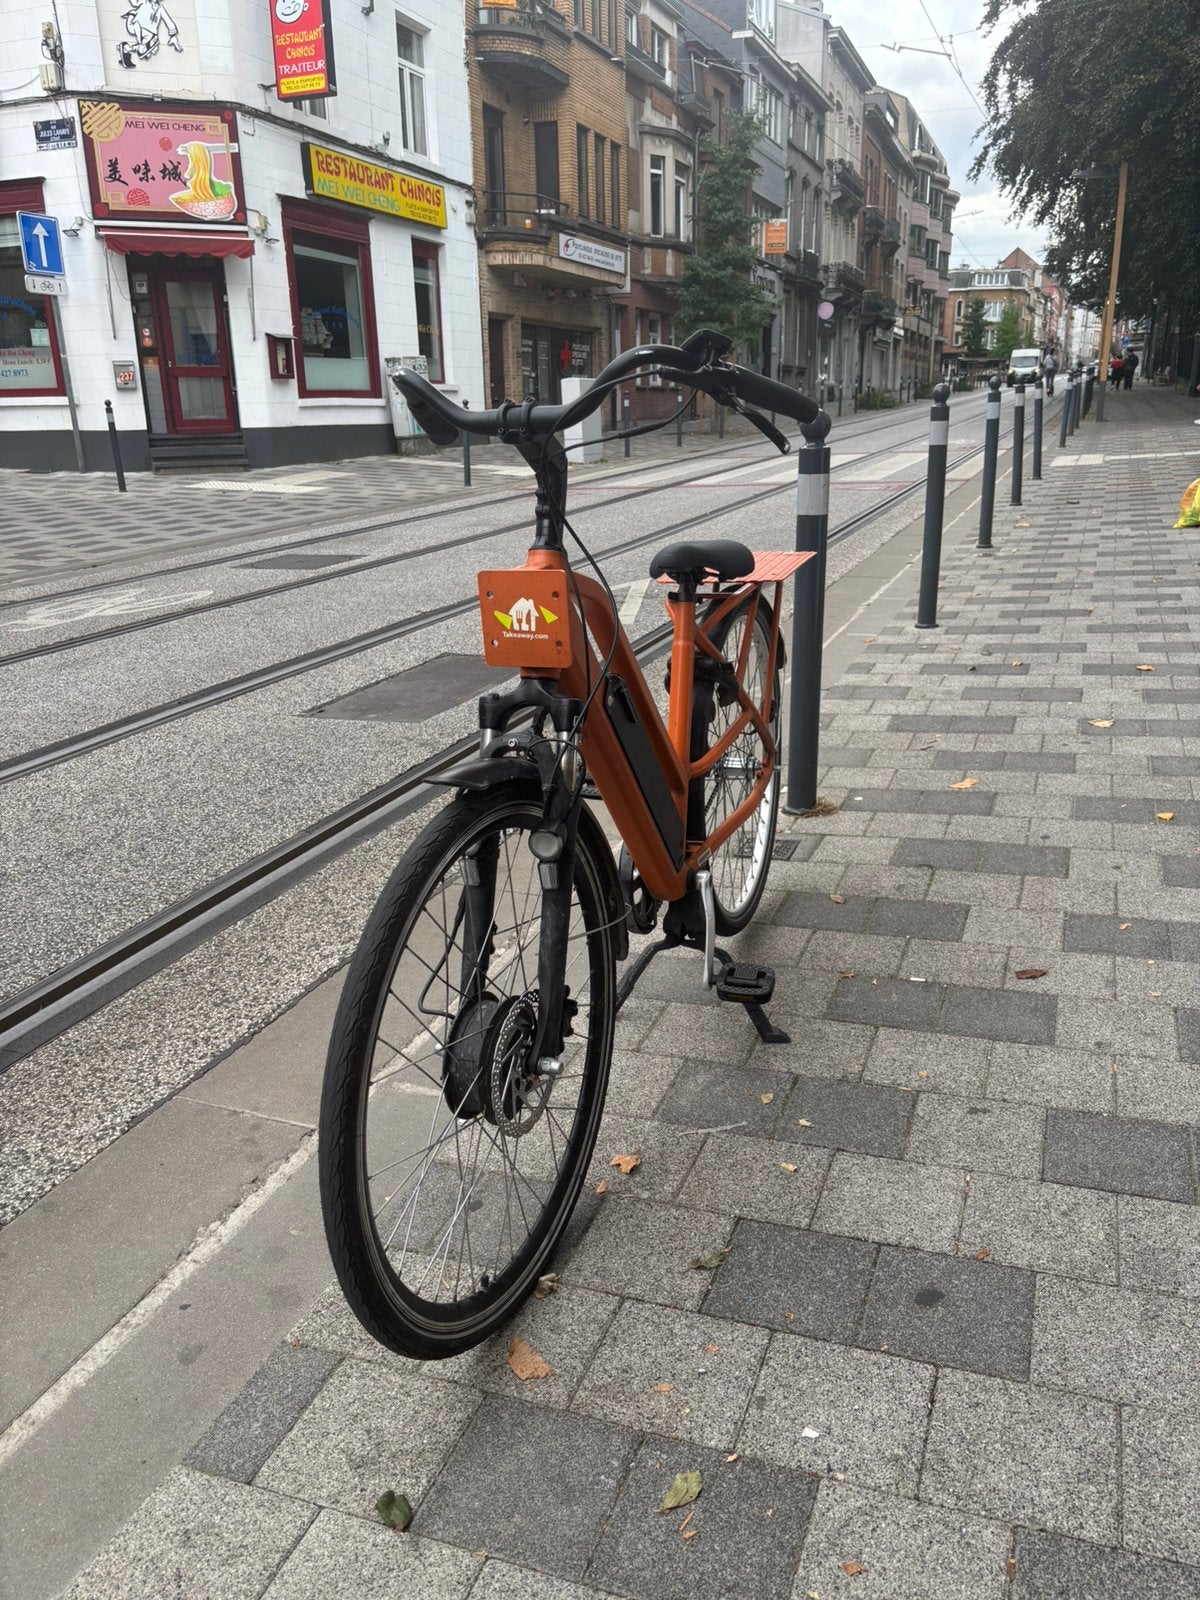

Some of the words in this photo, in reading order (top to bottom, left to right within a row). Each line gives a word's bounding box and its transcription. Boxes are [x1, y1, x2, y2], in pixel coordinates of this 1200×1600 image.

[276, 28, 323, 46] RESTAURANT
[286, 45, 315, 59] CHINOIS
[278, 60, 326, 75] TRAITEUR
[125, 120, 145, 129] MEI
[147, 121, 170, 130] WEI
[172, 123, 206, 132] CHENG
[315, 150, 396, 193] RESTAURANT
[400, 178, 442, 208] CHINOIS
[317, 177, 339, 196] MEI
[342, 184, 365, 203] WEI
[366, 191, 400, 213] CHENG
[1, 369, 12, 378] 427
[13, 368, 29, 378] 8973
[119, 371, 134, 381] 237
[502, 630, 549, 640] Takeaway.com
